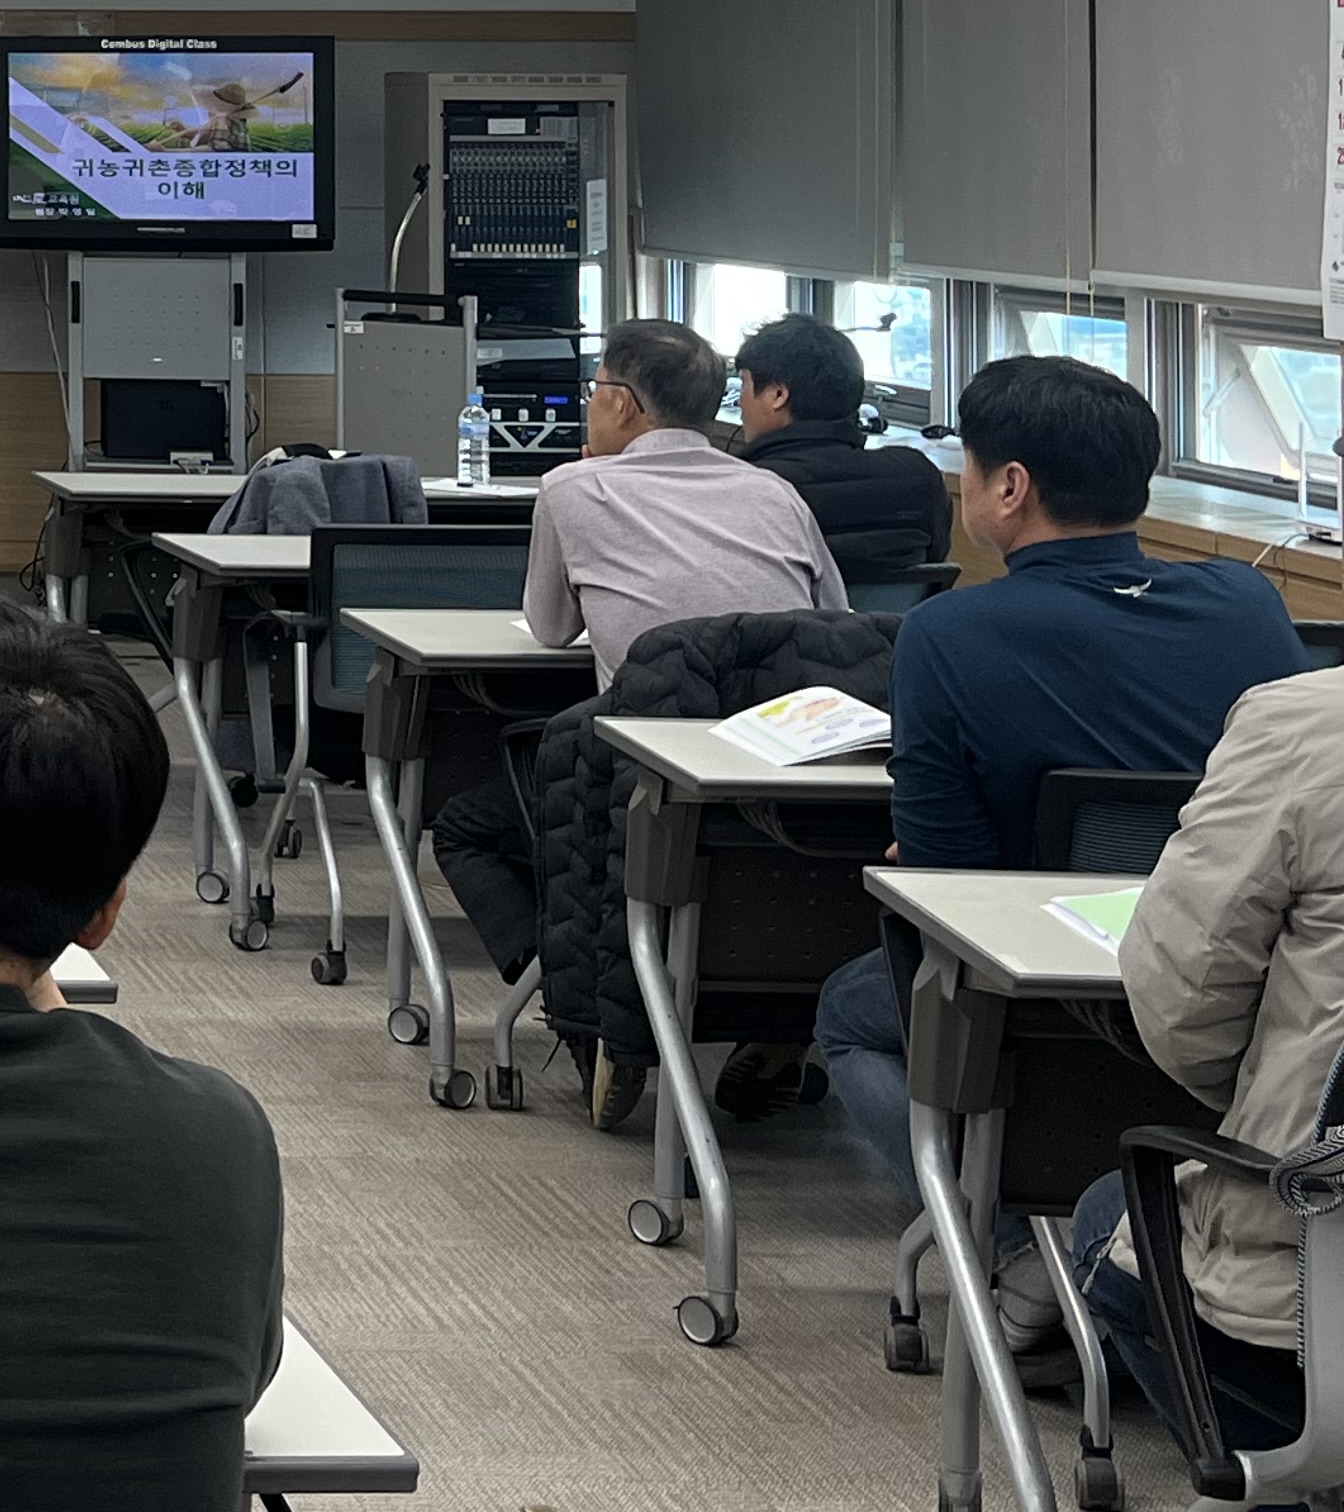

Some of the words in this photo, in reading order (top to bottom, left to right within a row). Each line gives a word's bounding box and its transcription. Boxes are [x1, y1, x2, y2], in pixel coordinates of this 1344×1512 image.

[148, 38, 184, 51] Digital
[186, 38, 218, 50] Class
[72, 158, 299, 178] 귀농귀촌종합정책의
[157, 180, 206, 200] 이해
